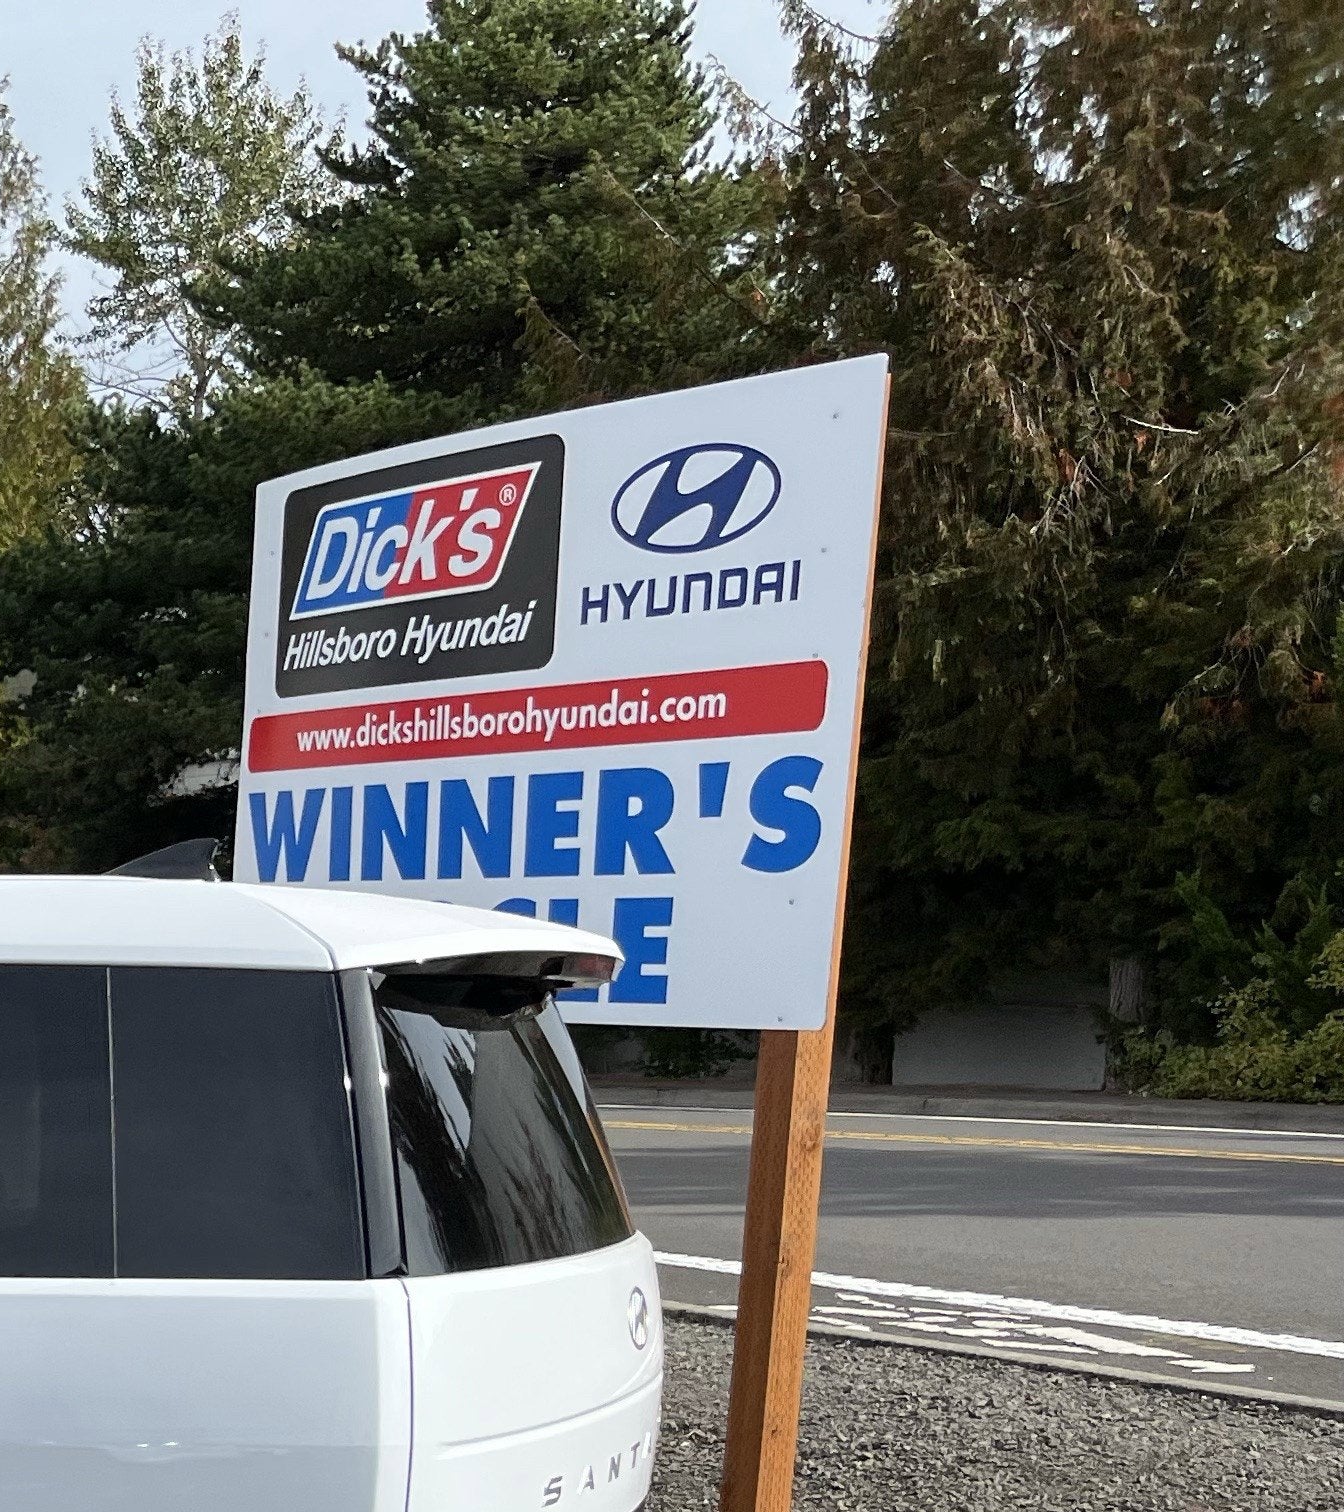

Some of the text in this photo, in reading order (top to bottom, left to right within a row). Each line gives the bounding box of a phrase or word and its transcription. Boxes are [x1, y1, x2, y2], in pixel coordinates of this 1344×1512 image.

[305, 487, 502, 601] Dick's
[580, 559, 802, 626] HYUNDAI
[283, 599, 538, 671] Hillsboro Hyundai
[297, 688, 728, 753] www.dickshillsborohyundai.com
[249, 755, 824, 883] WINNER'S
